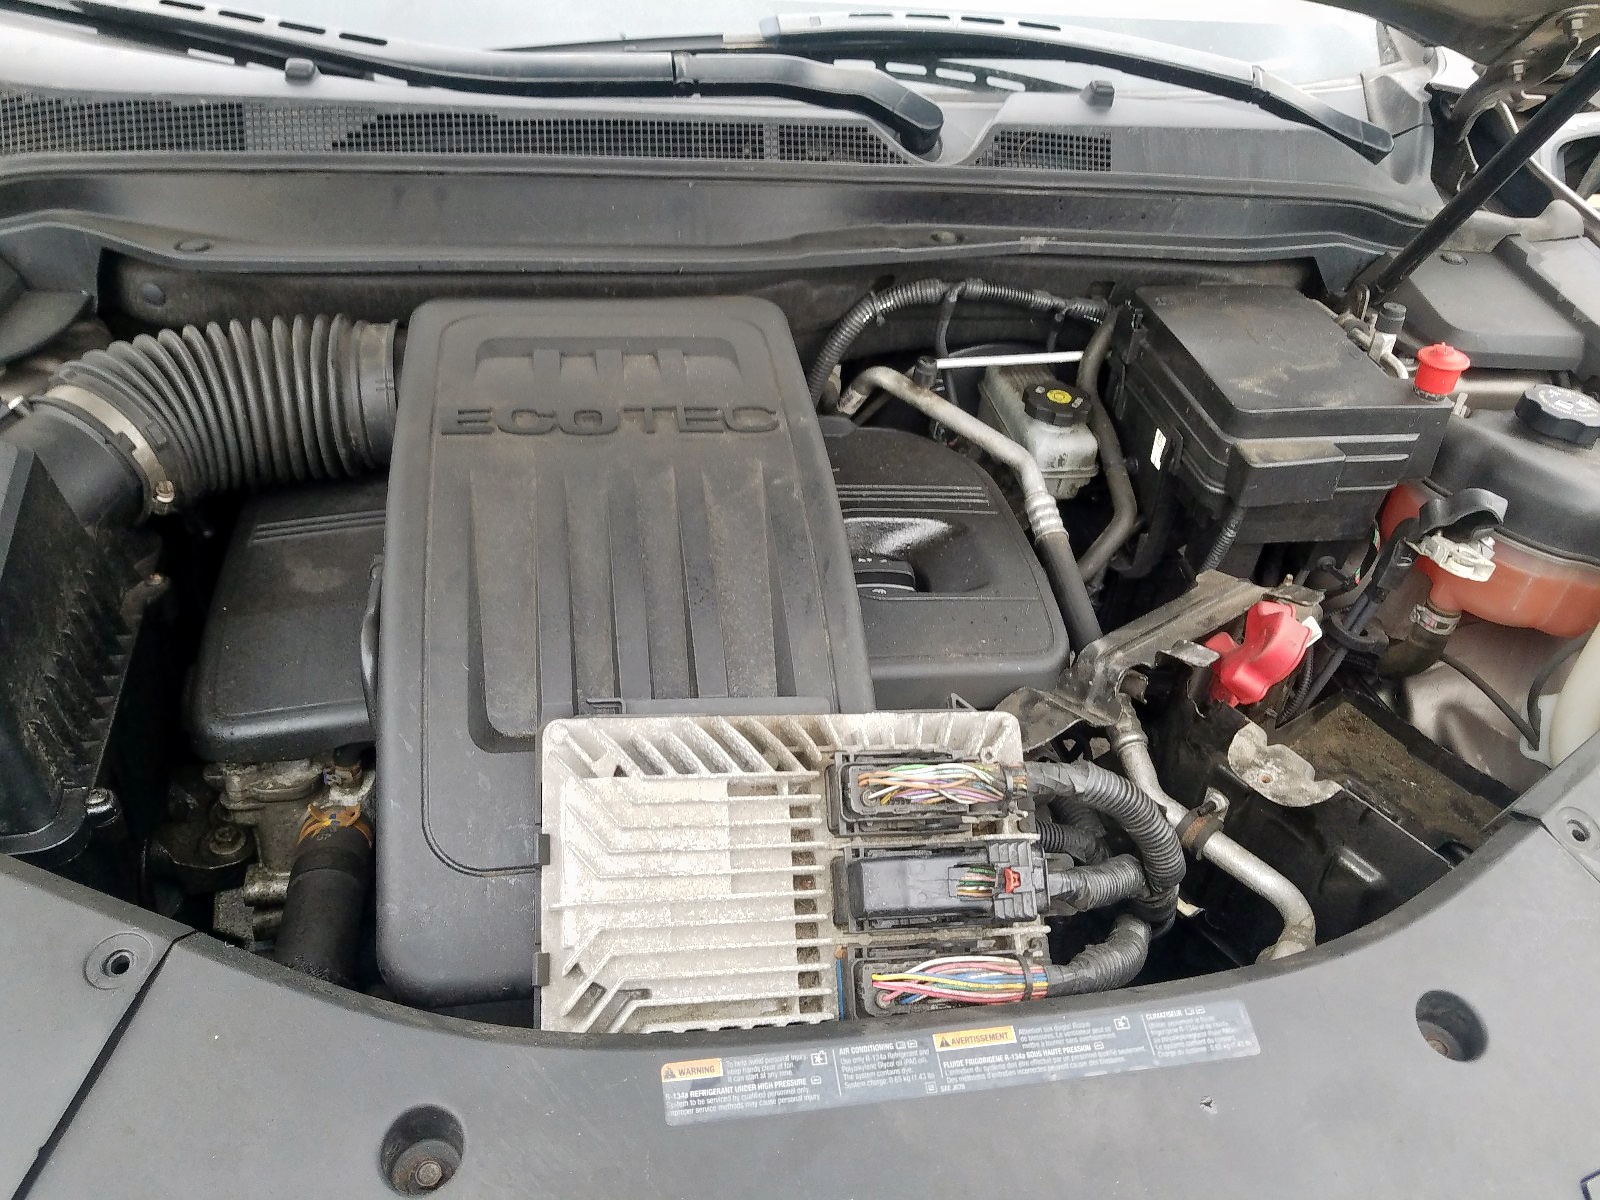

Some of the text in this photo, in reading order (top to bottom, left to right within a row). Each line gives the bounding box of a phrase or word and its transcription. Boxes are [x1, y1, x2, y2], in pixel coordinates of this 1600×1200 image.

[441, 405, 781, 436] ECOTEC
[1146, 1010, 1182, 1020] CLIMATISEUR
[952, 1032, 1009, 1045] AVERTISSEMENT
[839, 1043, 894, 1055] AIR CONDITIONING
[748, 1057, 764, 1066] avoid
[764, 1054, 790, 1065] personal
[841, 1057, 851, 1065] Use
[852, 1056, 865, 1064] only
[865, 1054, 886, 1062] R-134a
[888, 1050, 918, 1059] Refrigerant
[943, 1060, 964, 1068] FLUIDE
[1005, 1053, 1025, 1062] R-134a
[1026, 1050, 1042, 1059] SOUS
[1043, 1048, 1062, 1057] HAUTE
[1063, 1044, 1091, 1054] PRESSION
[678, 1066, 715, 1076] WARNING
[742, 1065, 760, 1073] hands
[761, 1064, 775, 1072] clear
[842, 1063, 877, 1073] Polyalkylene
[878, 1061, 895, 1069] Glycol
[745, 1073, 759, 1081] start
[855, 1070, 875, 1080] system
[877, 1068, 901, 1077] contains
[665, 1077, 807, 1101] R-134a REFRIGERANT UNDER HIGH PRESSURE
[844, 1080, 866, 1090] System
[707, 1095, 732, 1104] serviced
[732, 1094, 740, 1102] by
[767, 1088, 796, 1098] personnel
[696, 1105, 717, 1114] service
[718, 1102, 744, 1111] methods
[777, 1096, 802, 1105] personal
